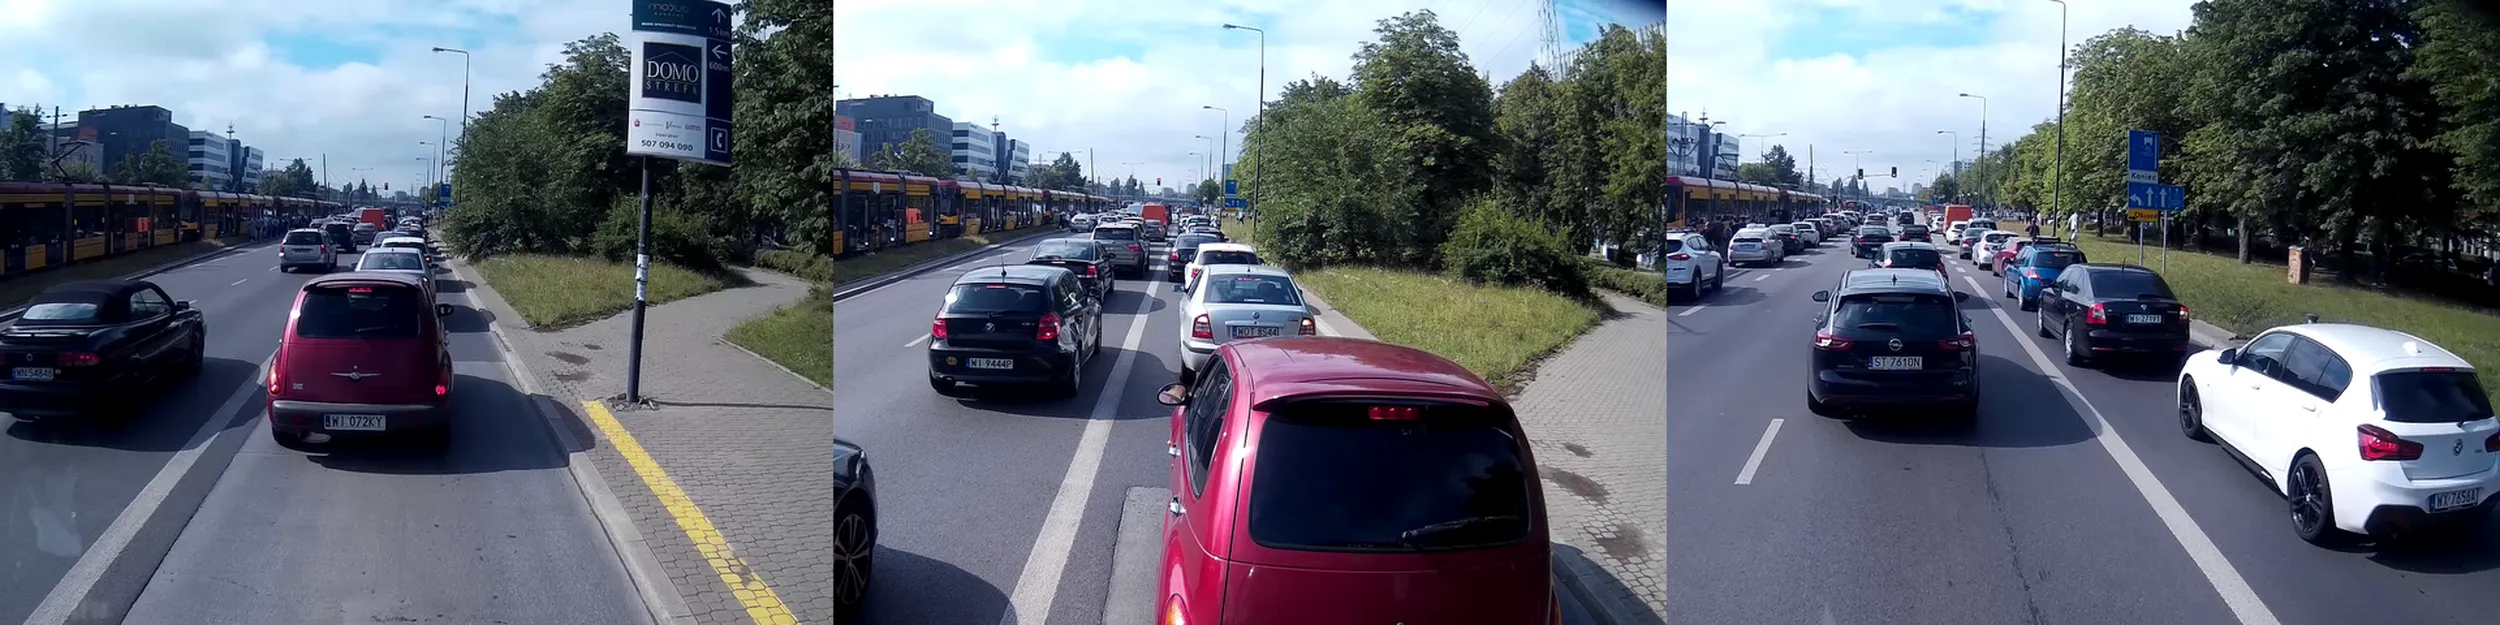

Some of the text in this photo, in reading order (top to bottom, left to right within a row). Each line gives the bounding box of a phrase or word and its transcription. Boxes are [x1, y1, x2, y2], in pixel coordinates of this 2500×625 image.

[646, 60, 699, 83] DOMO
[646, 80, 698, 95] STREFA
[641, 139, 694, 152] 507 094 090
[2131, 172, 2156, 181] Koniec
[970, 359, 982, 368] WI
[1874, 357, 1920, 367] ST 7610N
[332, 416, 383, 427] WI 072KY
